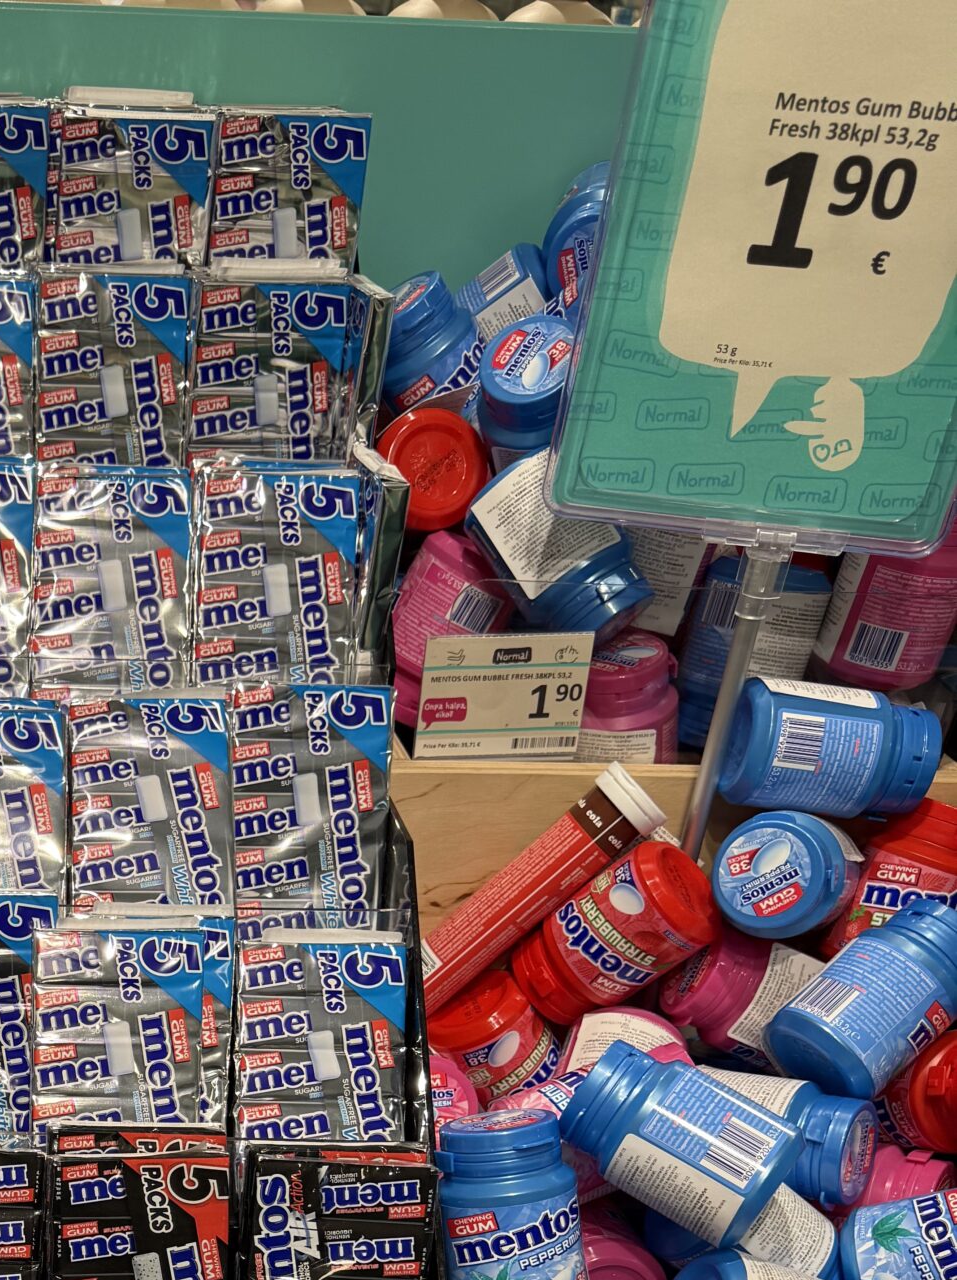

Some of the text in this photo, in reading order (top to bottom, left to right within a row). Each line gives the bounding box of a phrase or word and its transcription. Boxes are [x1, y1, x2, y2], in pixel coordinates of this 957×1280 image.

[775, 92, 850, 115] Mentos
[855, 97, 902, 119] Gum
[311, 122, 367, 163] 5
[769, 118, 940, 151] Fresh 38kpl 53,2g
[289, 122, 313, 190] PACKS
[871, 251, 890, 275] €
[502, 328, 542, 379] mentos
[549, 341, 567, 358] 38
[716, 343, 729, 354] 53
[645, 402, 702, 424] Normal
[495, 648, 530, 662] Normal
[430, 675, 462, 684] MENTOS
[463, 675, 481, 683] GUM
[482, 674, 510, 682] BUBBLE
[511, 673, 534, 682] FRESH
[357, 775, 366, 810] GUM
[585, 807, 605, 830] cola
[326, 763, 370, 928] mentos
[730, 860, 751, 874] 38
[876, 869, 917, 884] GUM
[878, 863, 919, 875] CHEWING
[741, 867, 802, 905] mentos
[141, 1166, 174, 1234] PACKS
[453, 1214, 492, 1227] CHEWING
[455, 1220, 497, 1235] GUM
[453, 1197, 580, 1269] mentos
